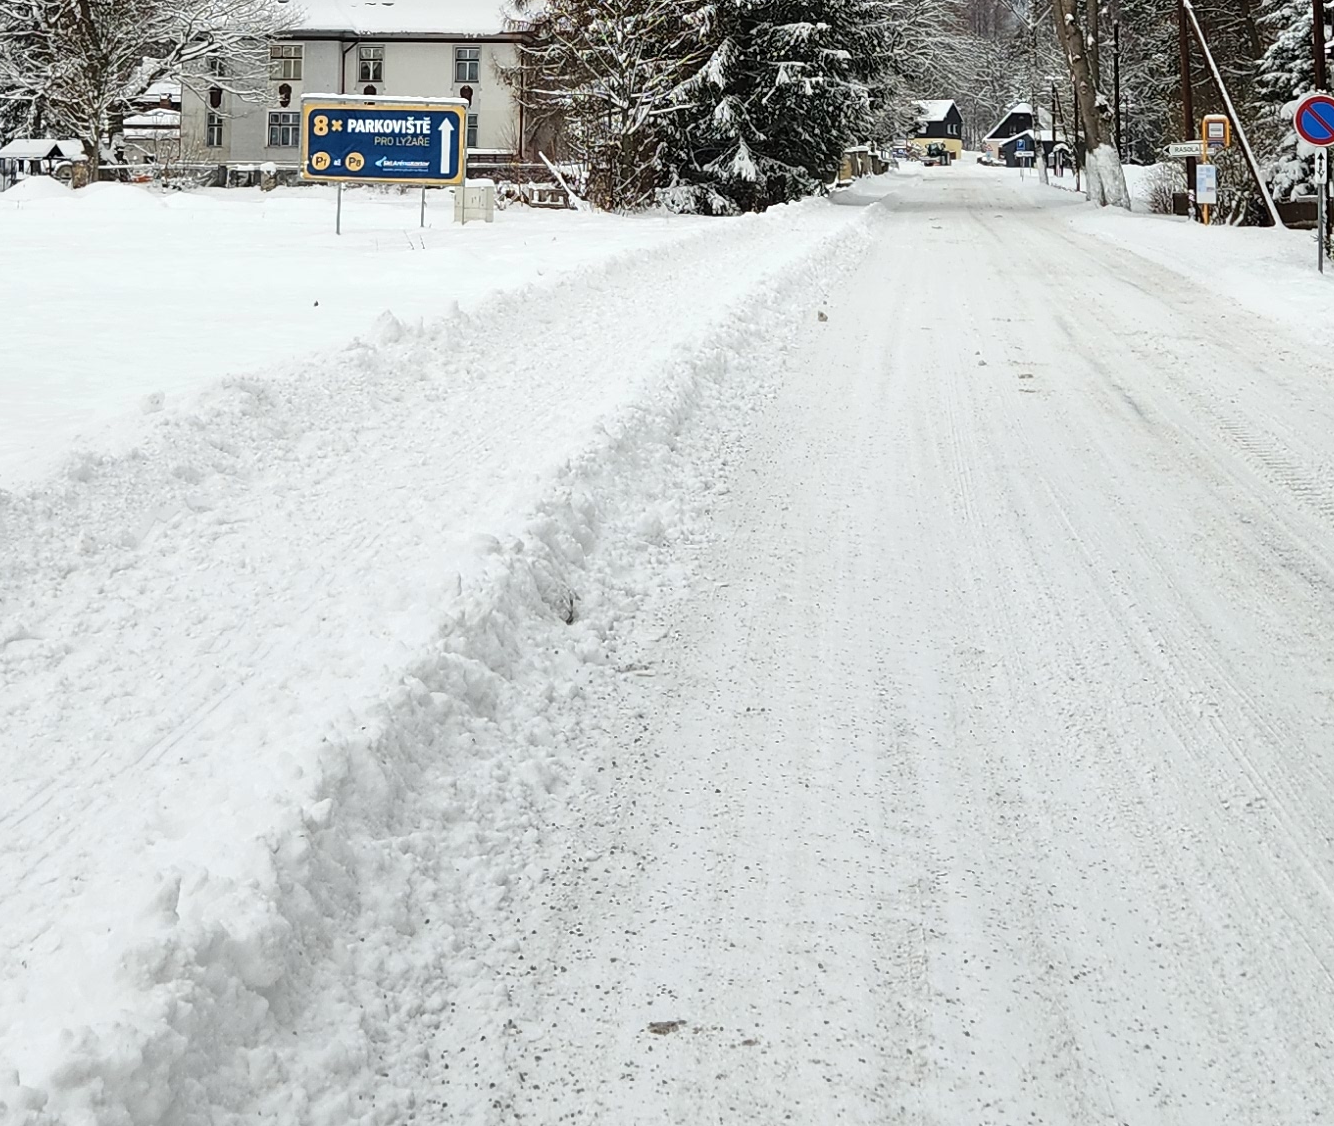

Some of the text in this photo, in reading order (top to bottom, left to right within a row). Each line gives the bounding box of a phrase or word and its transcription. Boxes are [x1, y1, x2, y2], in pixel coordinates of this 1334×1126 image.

[314, 115, 329, 136] 8
[347, 116, 431, 134] PARKOVIŠTĚ
[374, 135, 430, 146] PRO LYŽAŘE
